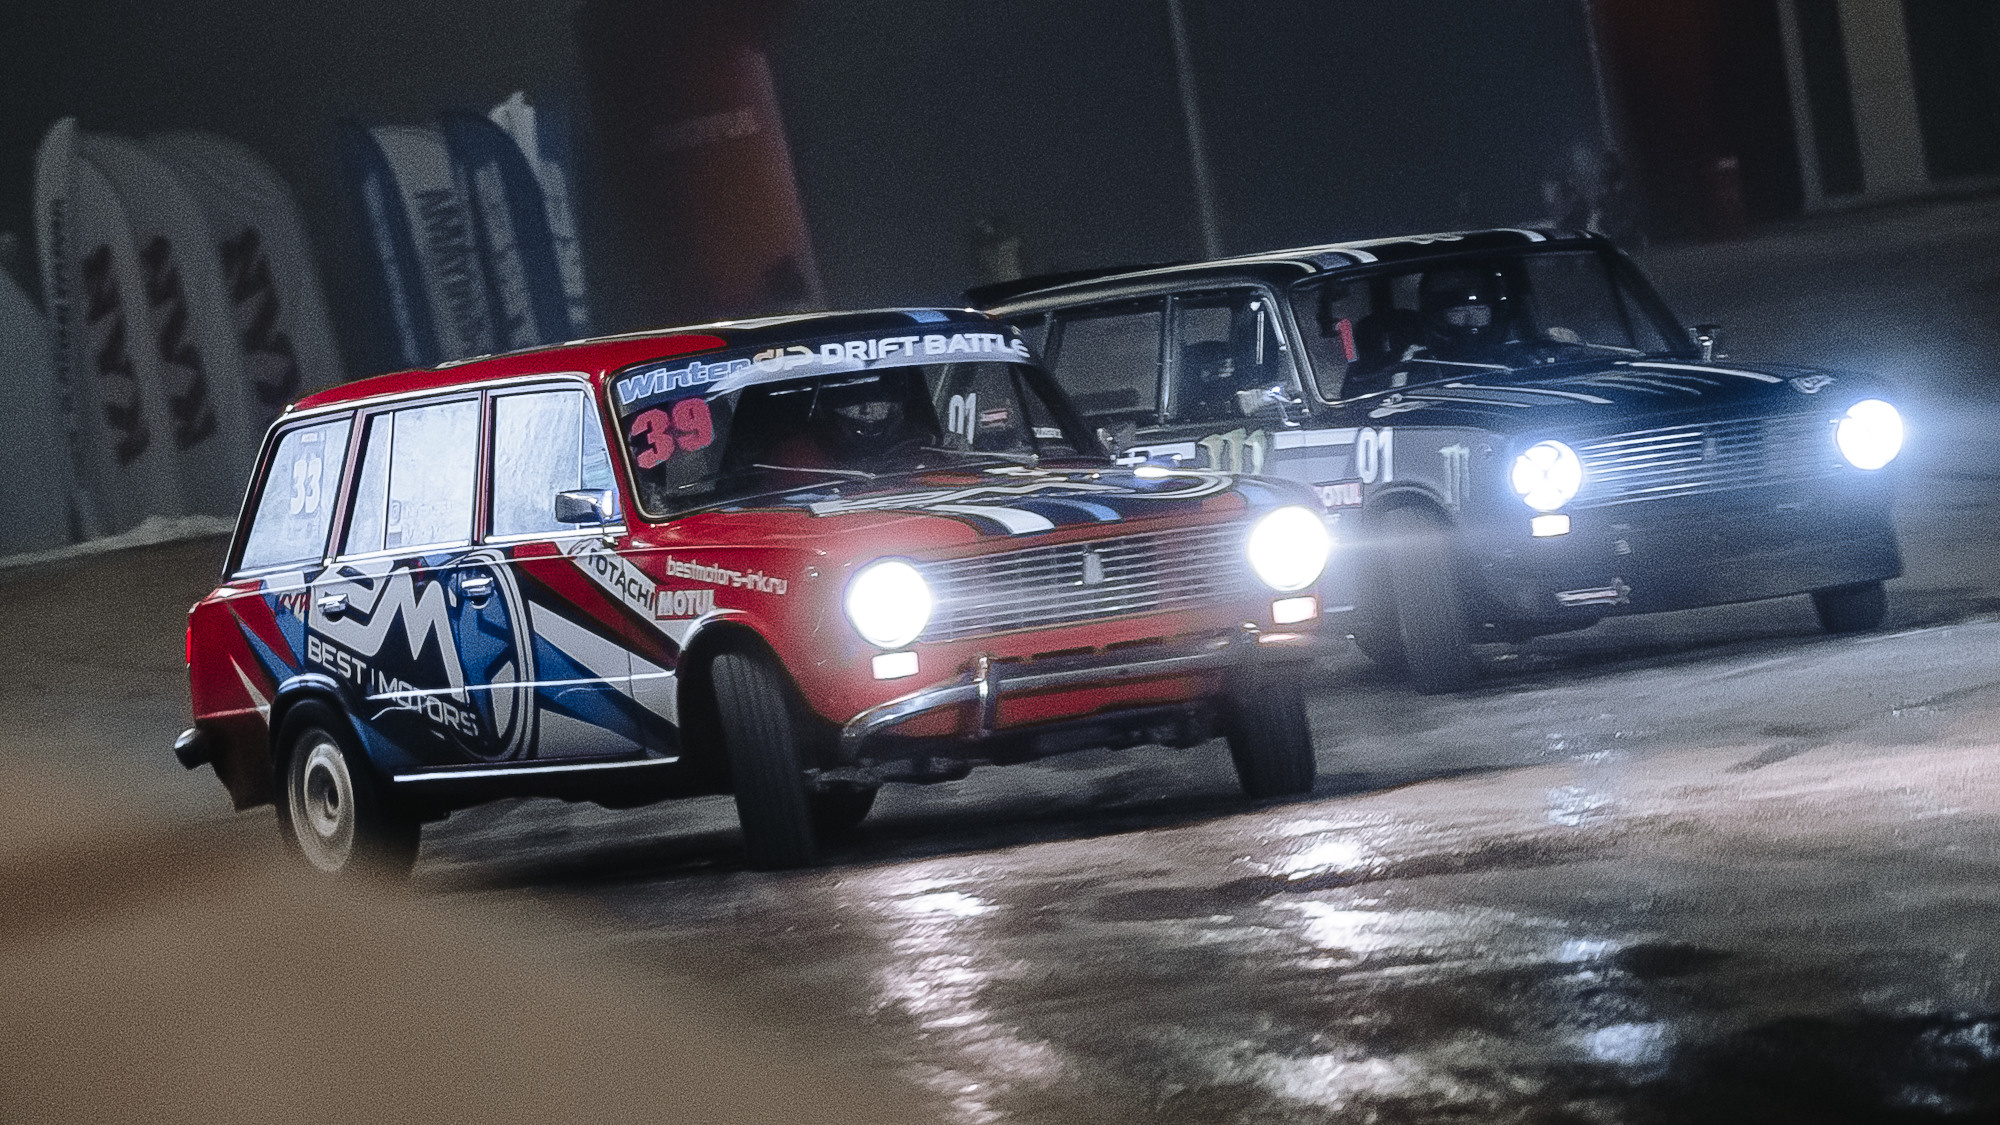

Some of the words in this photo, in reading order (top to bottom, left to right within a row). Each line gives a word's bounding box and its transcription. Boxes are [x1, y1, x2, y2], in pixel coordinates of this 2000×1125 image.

[616, 359, 751, 405] Winter
[819, 335, 920, 366] DRIFT
[923, 332, 1031, 358] BATTLE
[629, 398, 713, 469] 39
[1357, 426, 1394, 484] 01
[587, 549, 656, 611] TOTACHI
[656, 589, 717, 616] MOTUL
[307, 634, 367, 685] BEST
[378, 670, 479, 737] MOTORS
